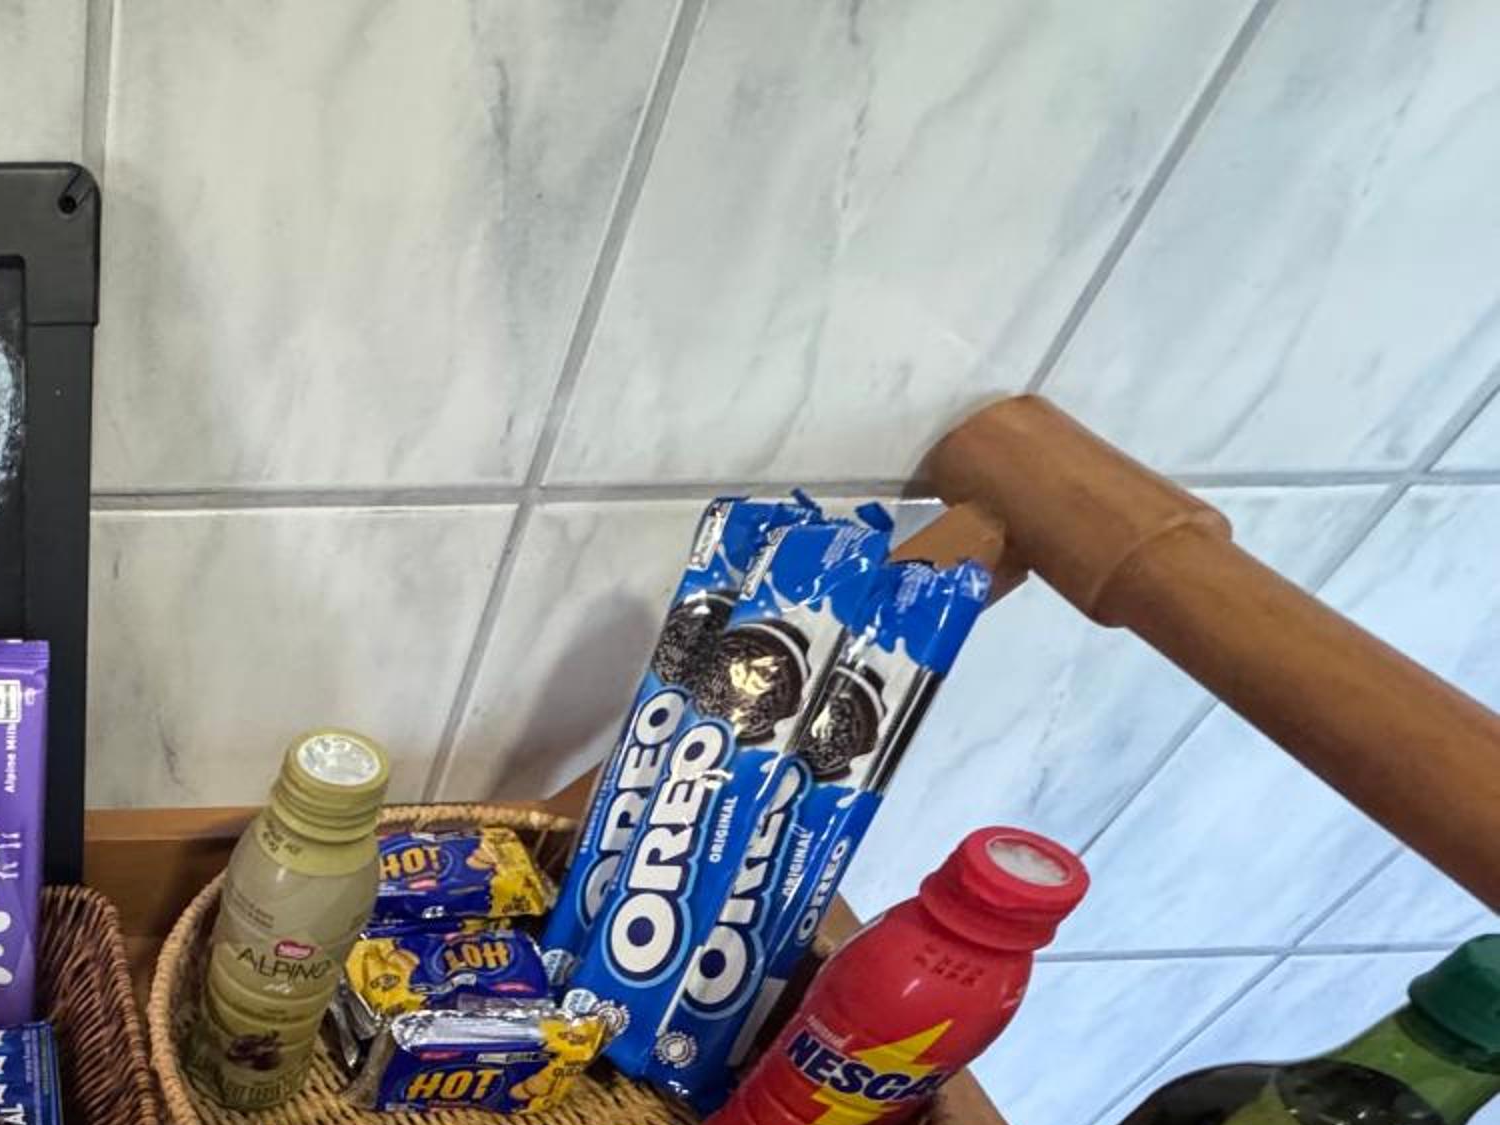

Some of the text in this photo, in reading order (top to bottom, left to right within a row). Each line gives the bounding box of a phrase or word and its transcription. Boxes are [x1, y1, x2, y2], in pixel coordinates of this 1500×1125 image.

[5, 753, 17, 793] Alpine
[610, 724, 723, 973] OREO
[709, 796, 739, 863] ORIGINAL
[782, 830, 814, 897] ORIGINAL
[444, 941, 511, 971] HOT
[407, 1069, 503, 1100] HOT
